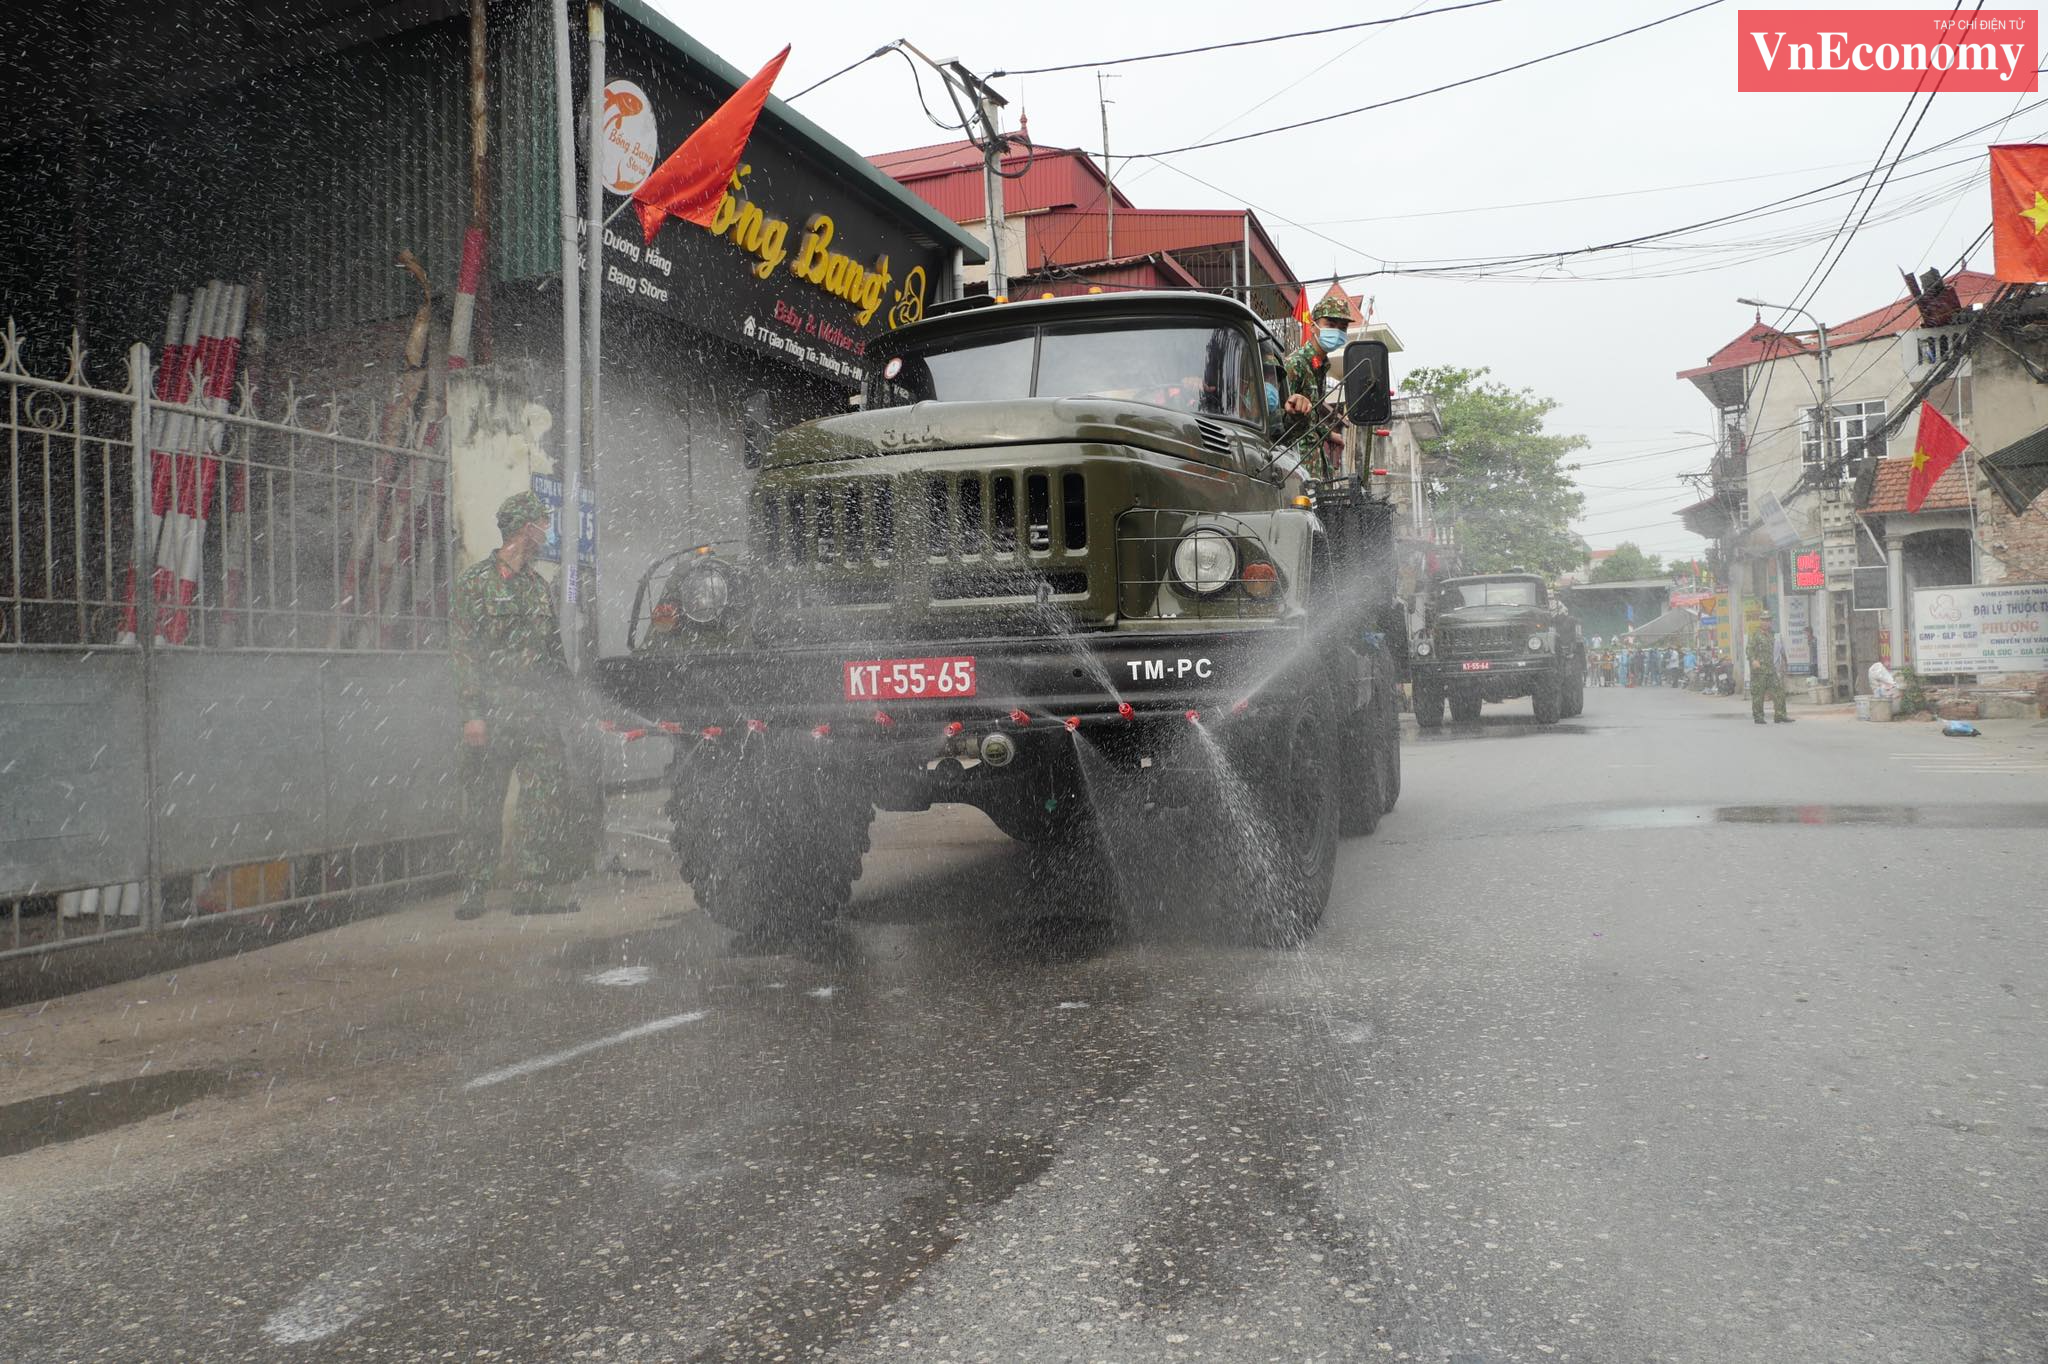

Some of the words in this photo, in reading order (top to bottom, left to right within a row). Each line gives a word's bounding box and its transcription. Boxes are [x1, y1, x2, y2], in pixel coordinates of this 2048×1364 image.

[626, 156, 647, 176] Store
[632, 142, 653, 167] Bang
[710, 164, 789, 280] ống
[794, 213, 883, 327] Bang
[608, 265, 637, 294] Bang
[639, 277, 668, 302] Store
[774, 300, 803, 334] Baby
[805, 314, 817, 336] &
[758, 327, 769, 342] TT
[769, 331, 784, 349] Giao
[785, 338, 805, 361] Thông
[849, 661, 971, 696] KT-55-65
[1126, 658, 1212, 680] TM-PC
